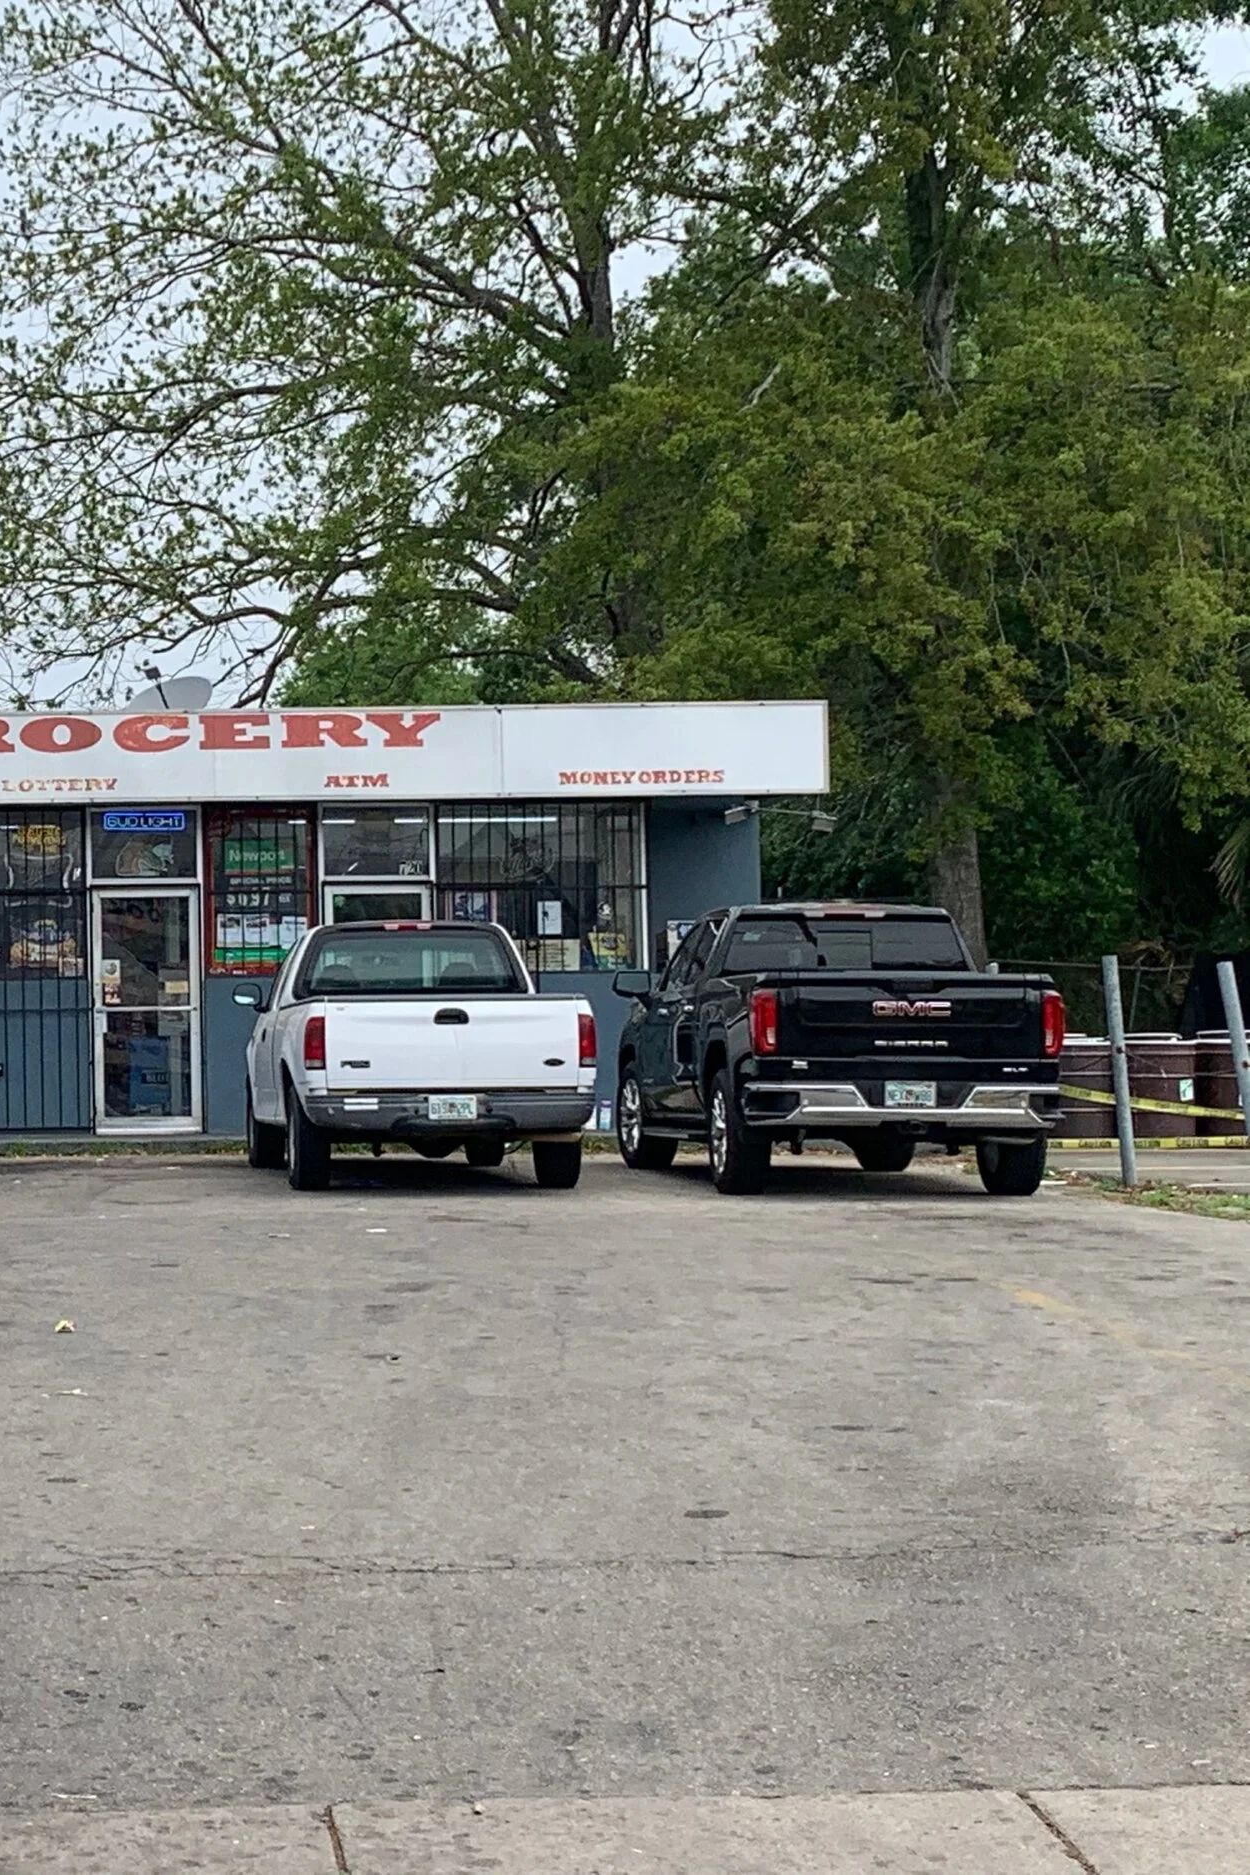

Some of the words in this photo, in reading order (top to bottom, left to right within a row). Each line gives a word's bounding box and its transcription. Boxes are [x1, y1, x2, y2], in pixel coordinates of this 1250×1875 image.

[1, 778, 118, 792] LOTTERY
[324, 772, 390, 788] ATM
[107, 816, 138, 827] BUD
[140, 816, 181, 828] LIGHT
[229, 849, 286, 863] Nwpot
[872, 1001, 951, 1017] GMC
